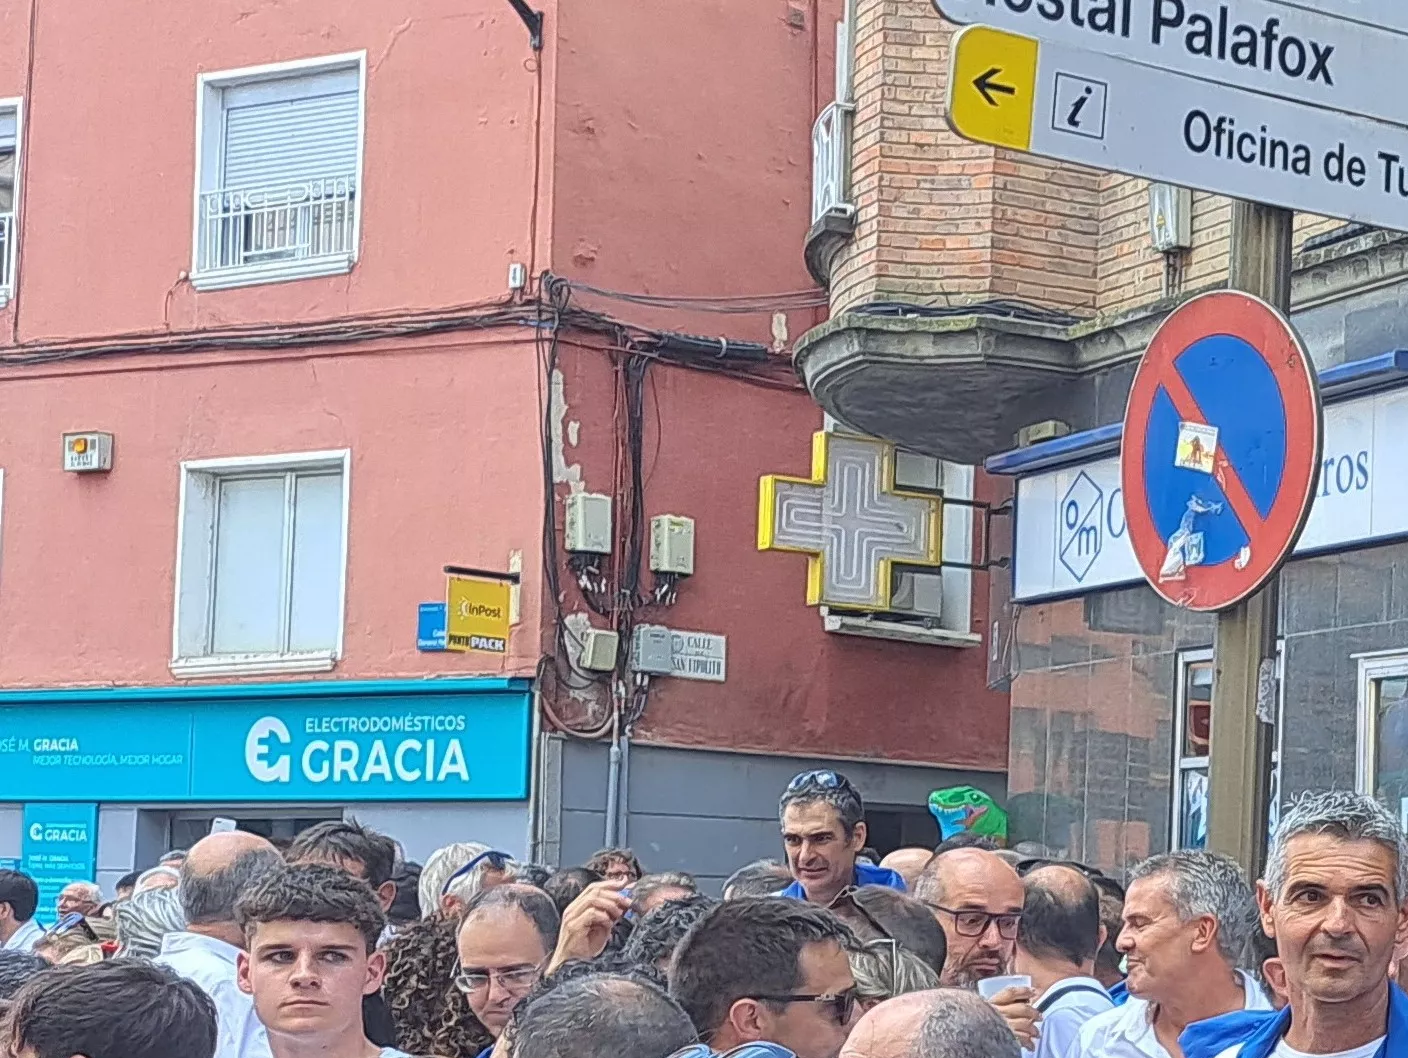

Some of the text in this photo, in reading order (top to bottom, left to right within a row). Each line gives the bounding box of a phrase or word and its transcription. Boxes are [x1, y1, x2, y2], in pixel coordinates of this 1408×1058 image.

[985, 0, 1335, 86] stal Palafox
[1183, 109, 1311, 177] Oficina
[1323, 142, 1366, 187] de
[468, 602, 502, 619] InPost
[471, 636, 504, 651] PACK
[305, 712, 466, 733] ELECTRODOMÉSTICOS
[33, 738, 79, 752] GRACIA
[301, 738, 471, 783] GRACIA
[44, 828, 88, 843] GRACIA
